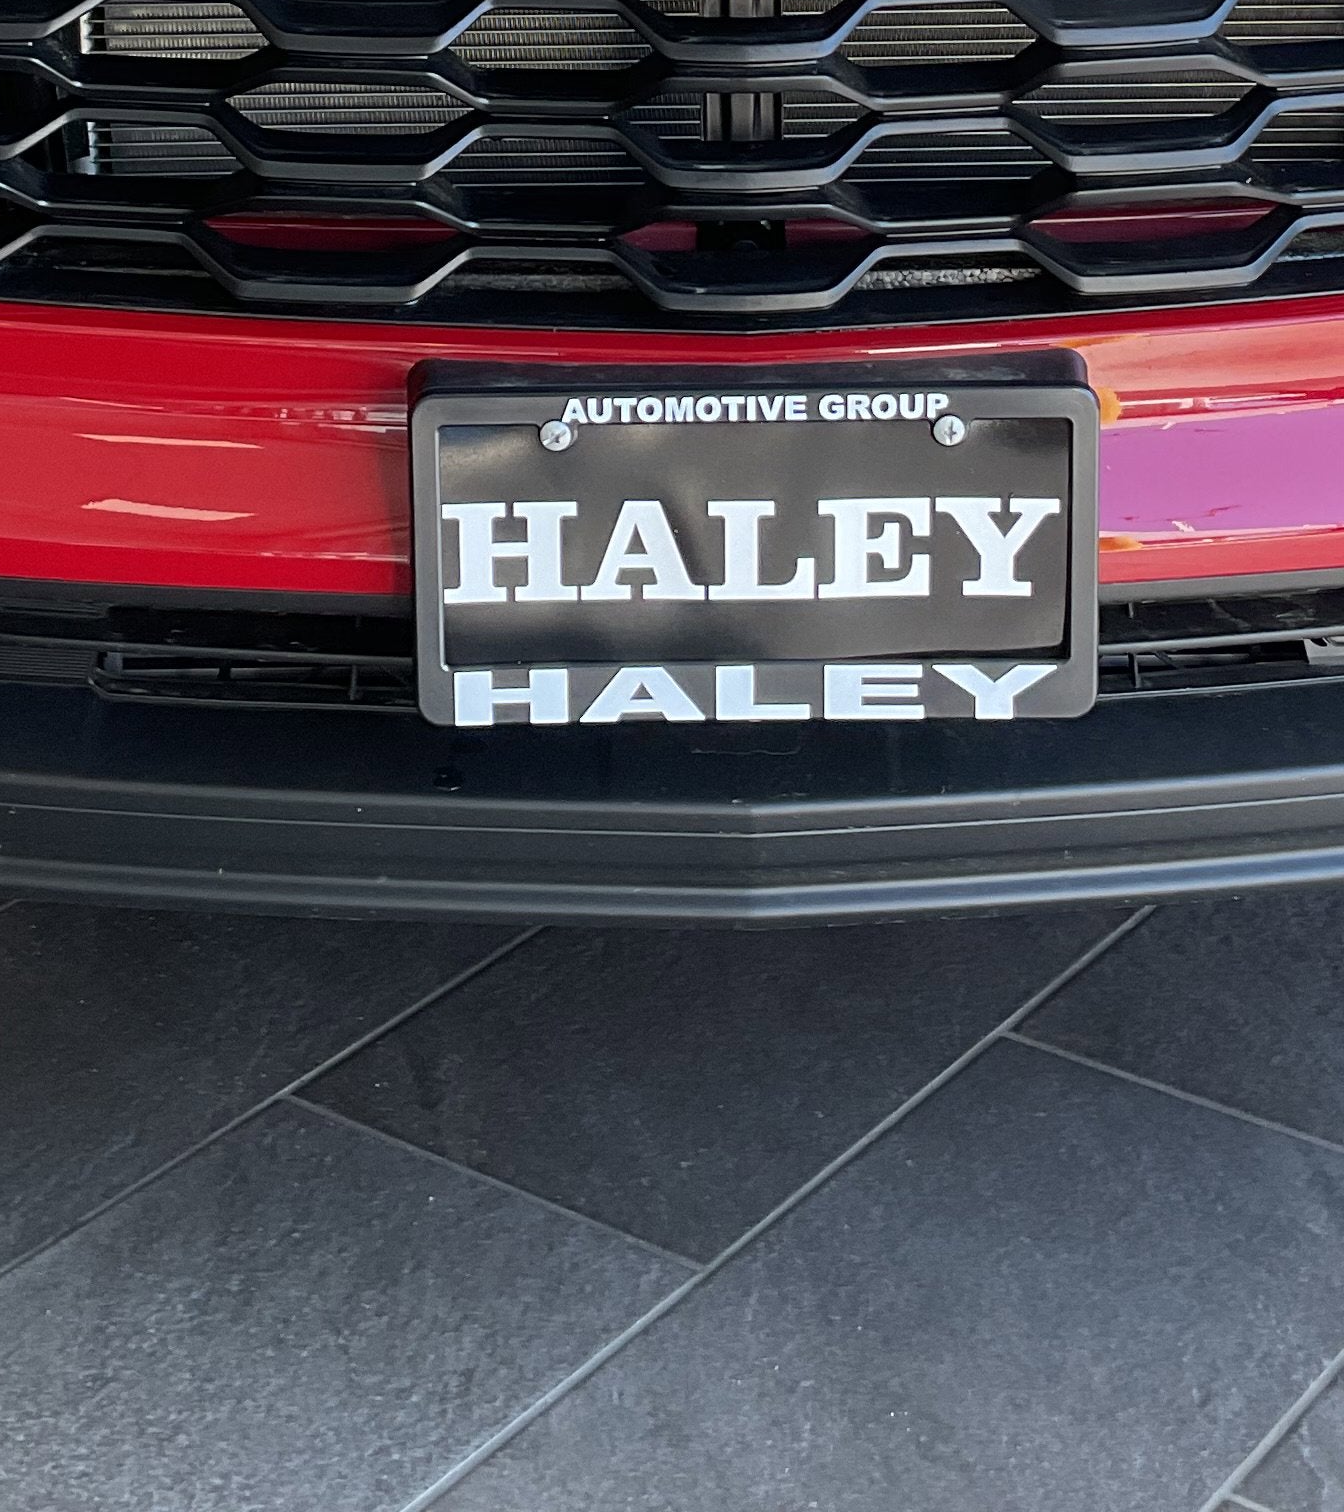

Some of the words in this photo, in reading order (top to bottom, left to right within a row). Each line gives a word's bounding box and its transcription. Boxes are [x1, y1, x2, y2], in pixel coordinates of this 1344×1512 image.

[561, 394, 808, 424] AUTOMOTIVE
[818, 392, 950, 420] GROUP
[441, 496, 1061, 605] HALEY
[454, 663, 1058, 727] HALEY
